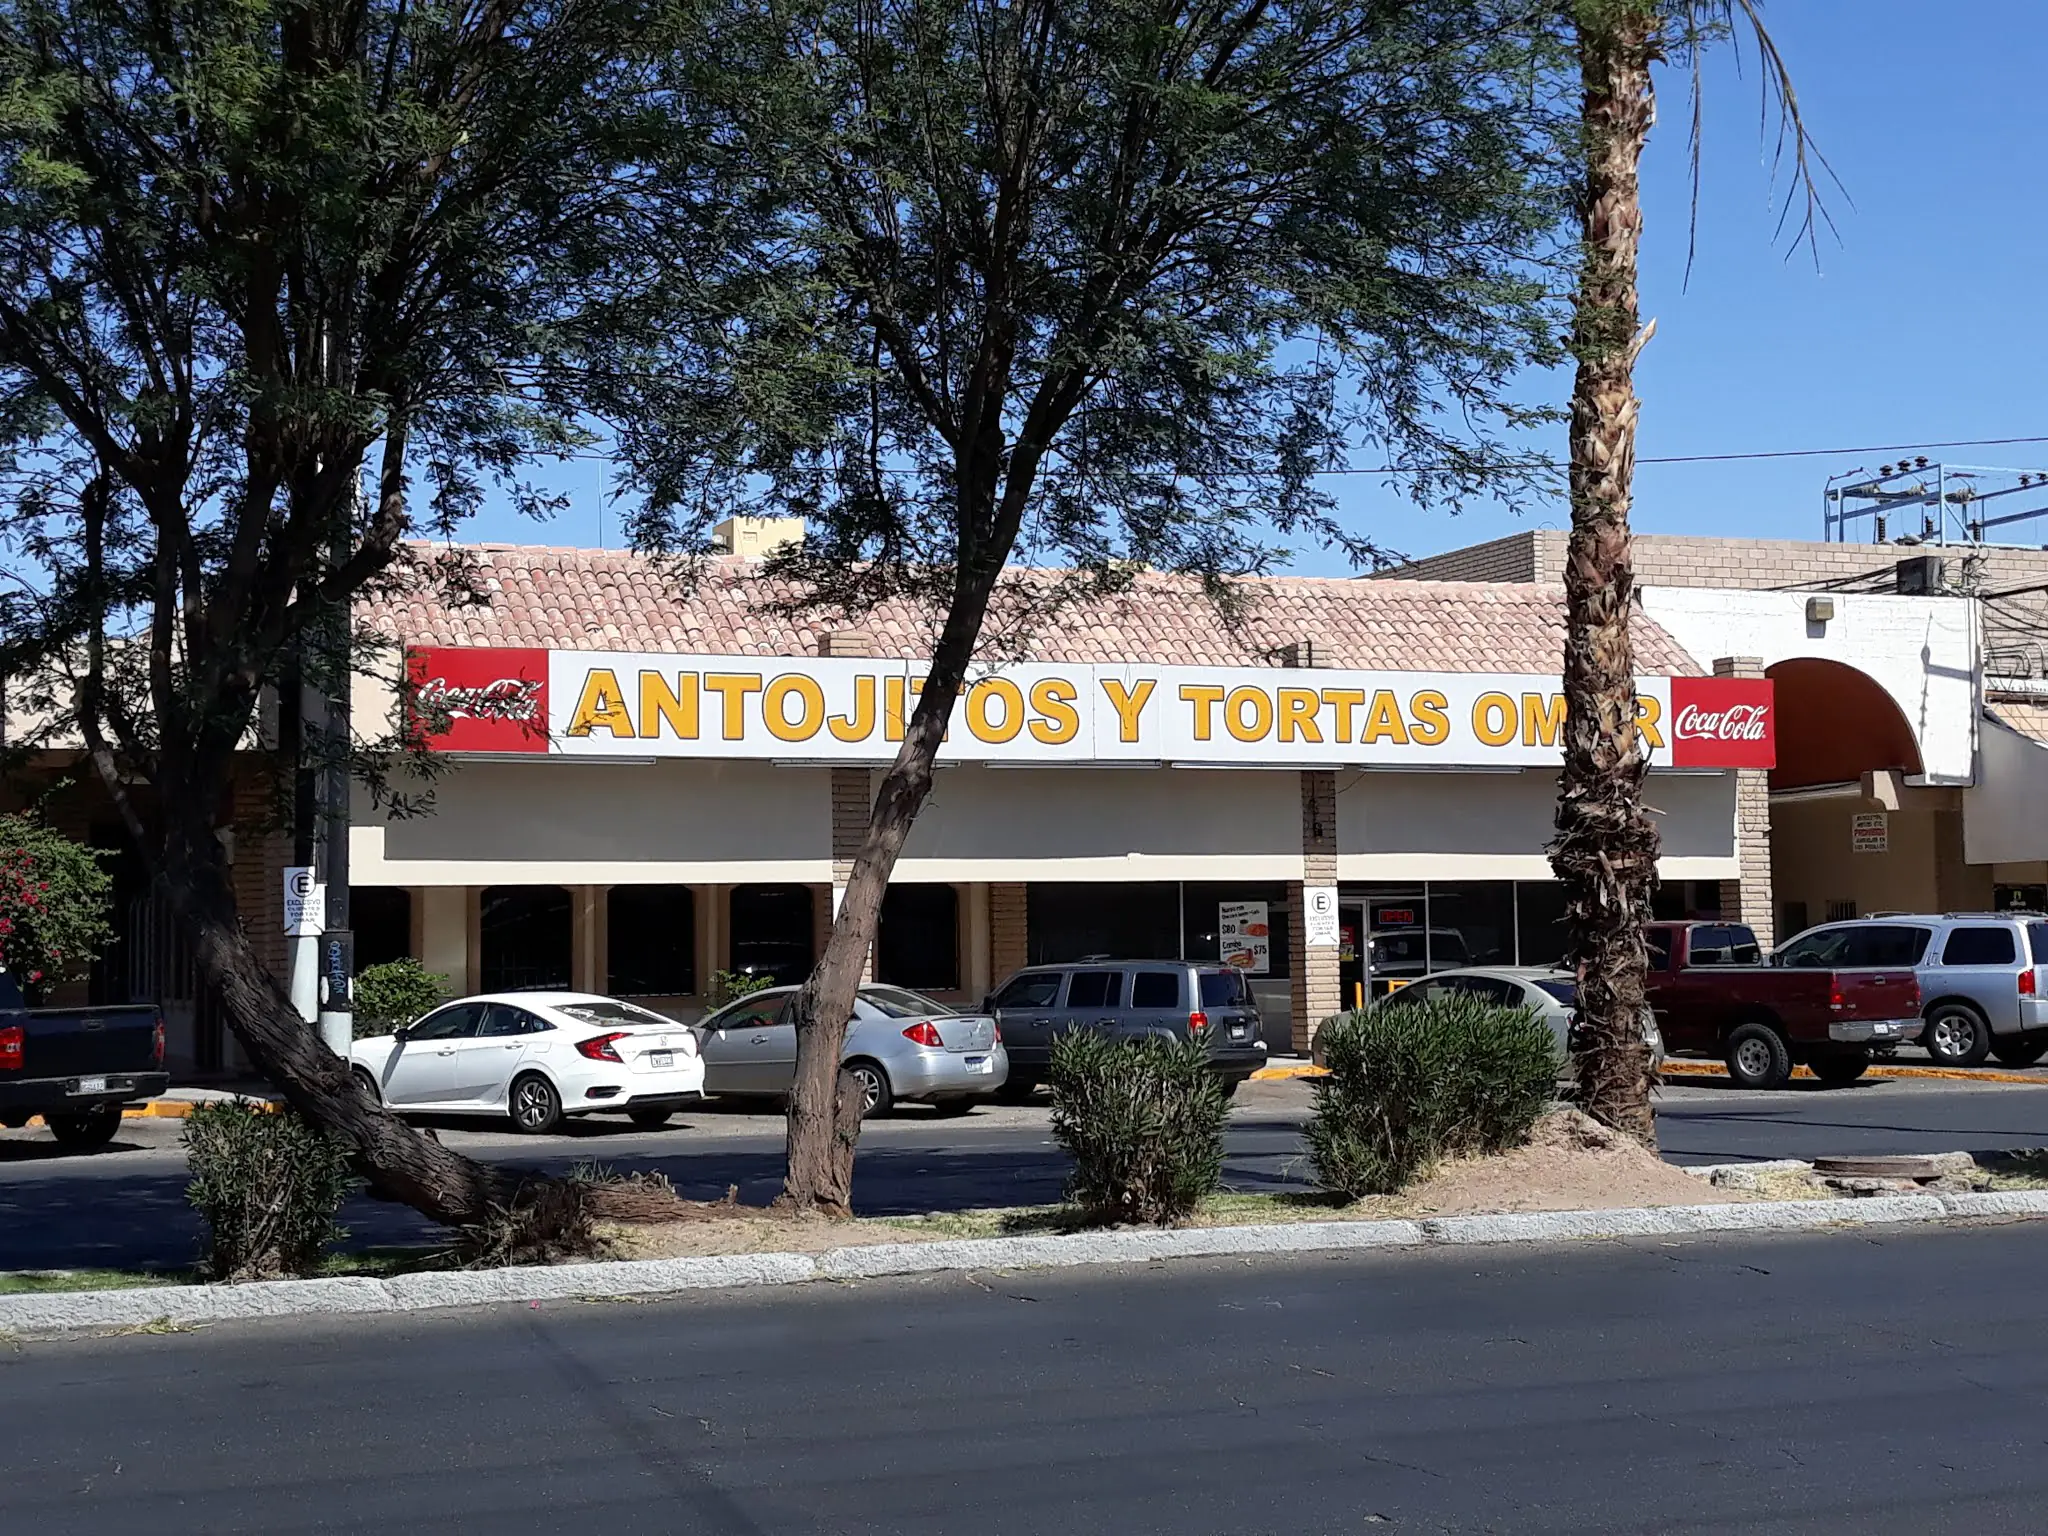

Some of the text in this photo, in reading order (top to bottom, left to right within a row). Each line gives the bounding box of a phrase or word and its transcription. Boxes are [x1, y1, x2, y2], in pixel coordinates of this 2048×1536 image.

[1099, 678, 1157, 743] Y
[1178, 684, 1451, 746] TORTAS
[1471, 690, 1666, 748] OMR
[1675, 703, 1770, 741] Coca-Cola
[297, 876, 310, 893] E
[1316, 895, 1327, 910] E
[1222, 924, 1236, 935] $80
[1253, 944, 1267, 956] $75
